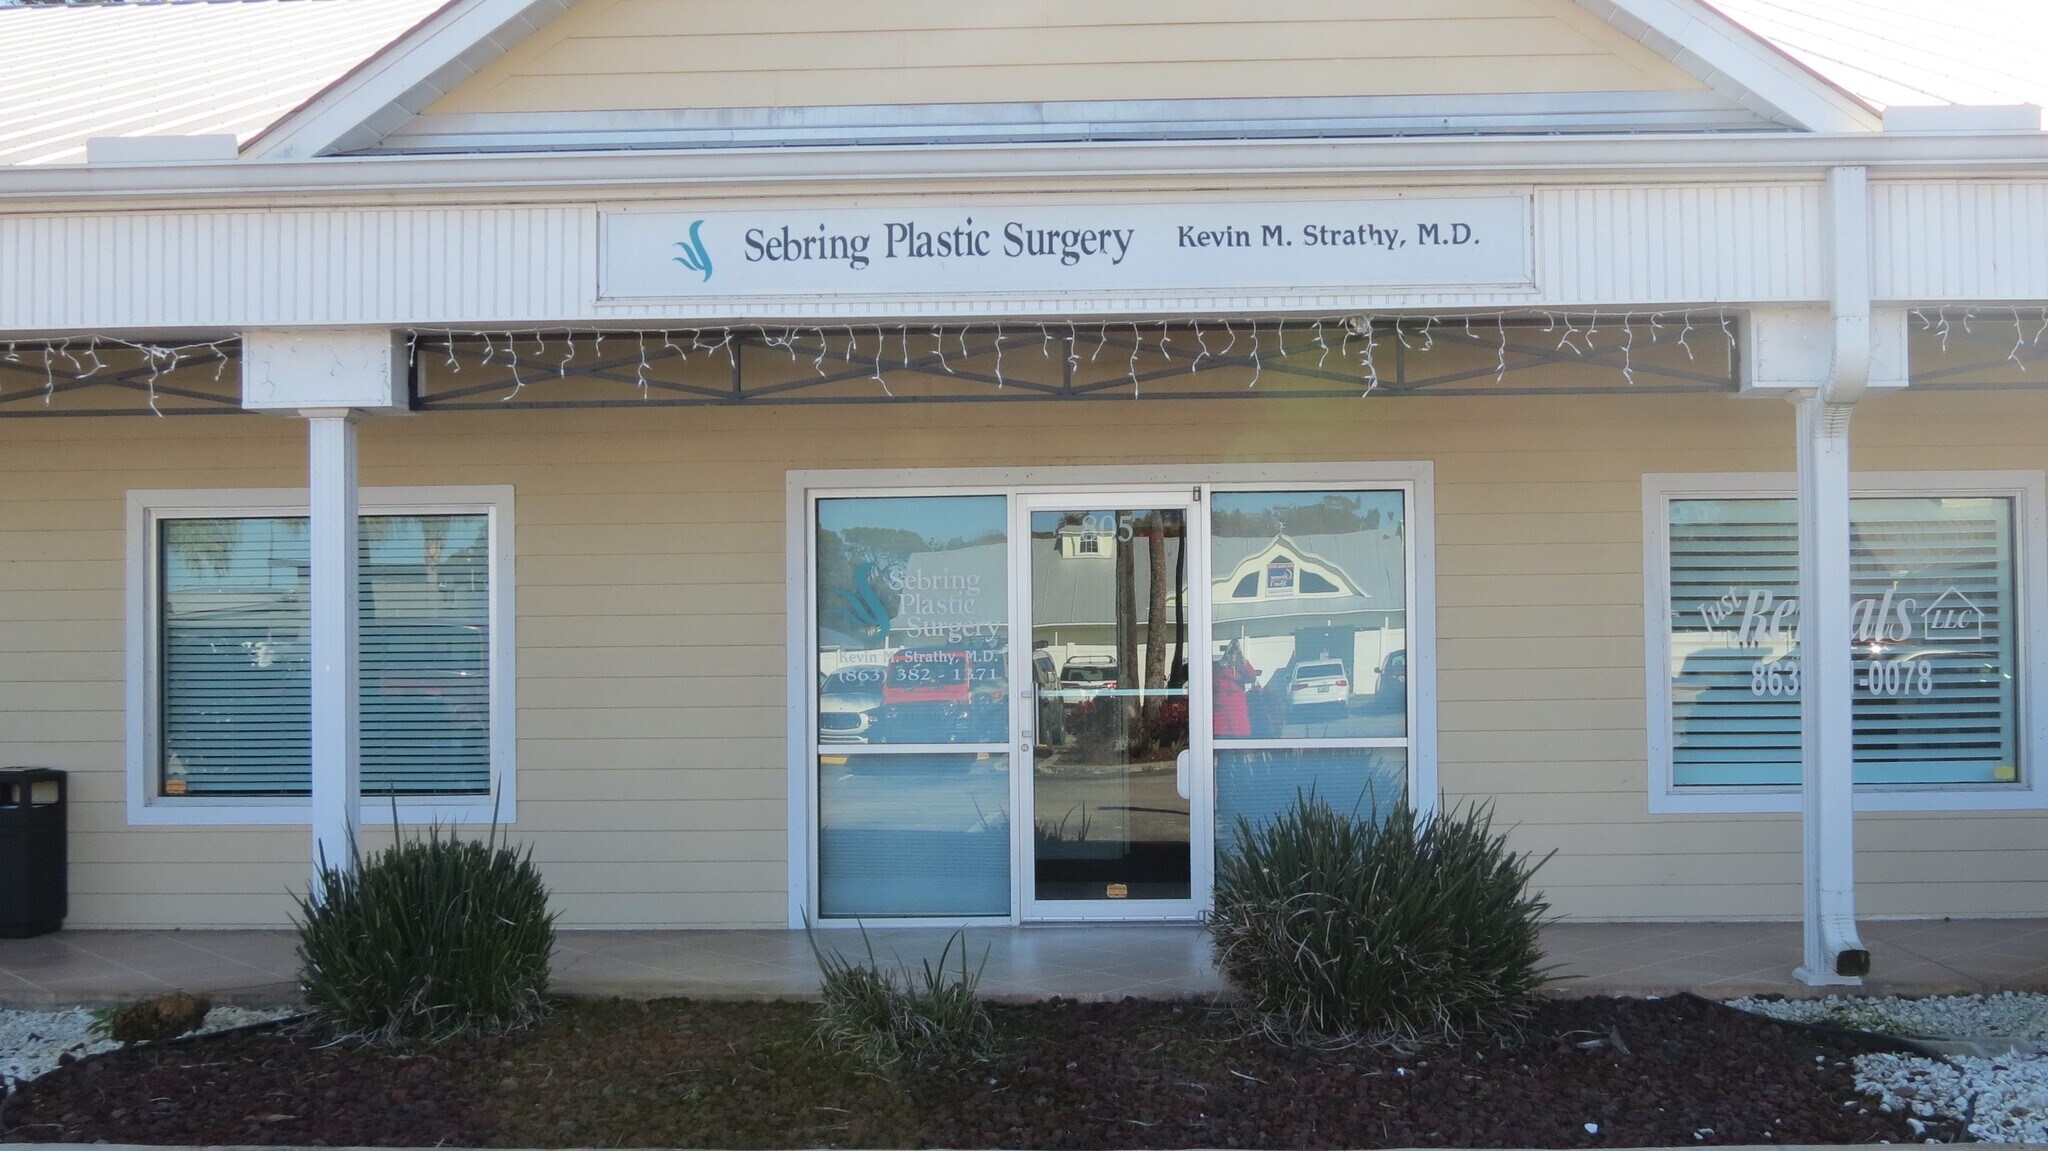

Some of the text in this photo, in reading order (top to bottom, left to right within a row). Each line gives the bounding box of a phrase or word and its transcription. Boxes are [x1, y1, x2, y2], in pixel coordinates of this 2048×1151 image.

[744, 217, 1135, 270] Sebring Plastic Surgery
[1177, 223, 1480, 250] Kevin M. Strathy, M.D.
[1081, 514, 1134, 542] 805
[889, 568, 981, 596] Sebring
[898, 591, 975, 615] Plastic
[1697, 586, 1972, 642] Just Reals LLC
[906, 616, 1000, 643] Surgery
[839, 650, 998, 666] Kevin M. Strathy, M.D.
[839, 668, 887, 684] (863)
[896, 668, 931, 681] 382
[953, 668, 997, 682] 1371
